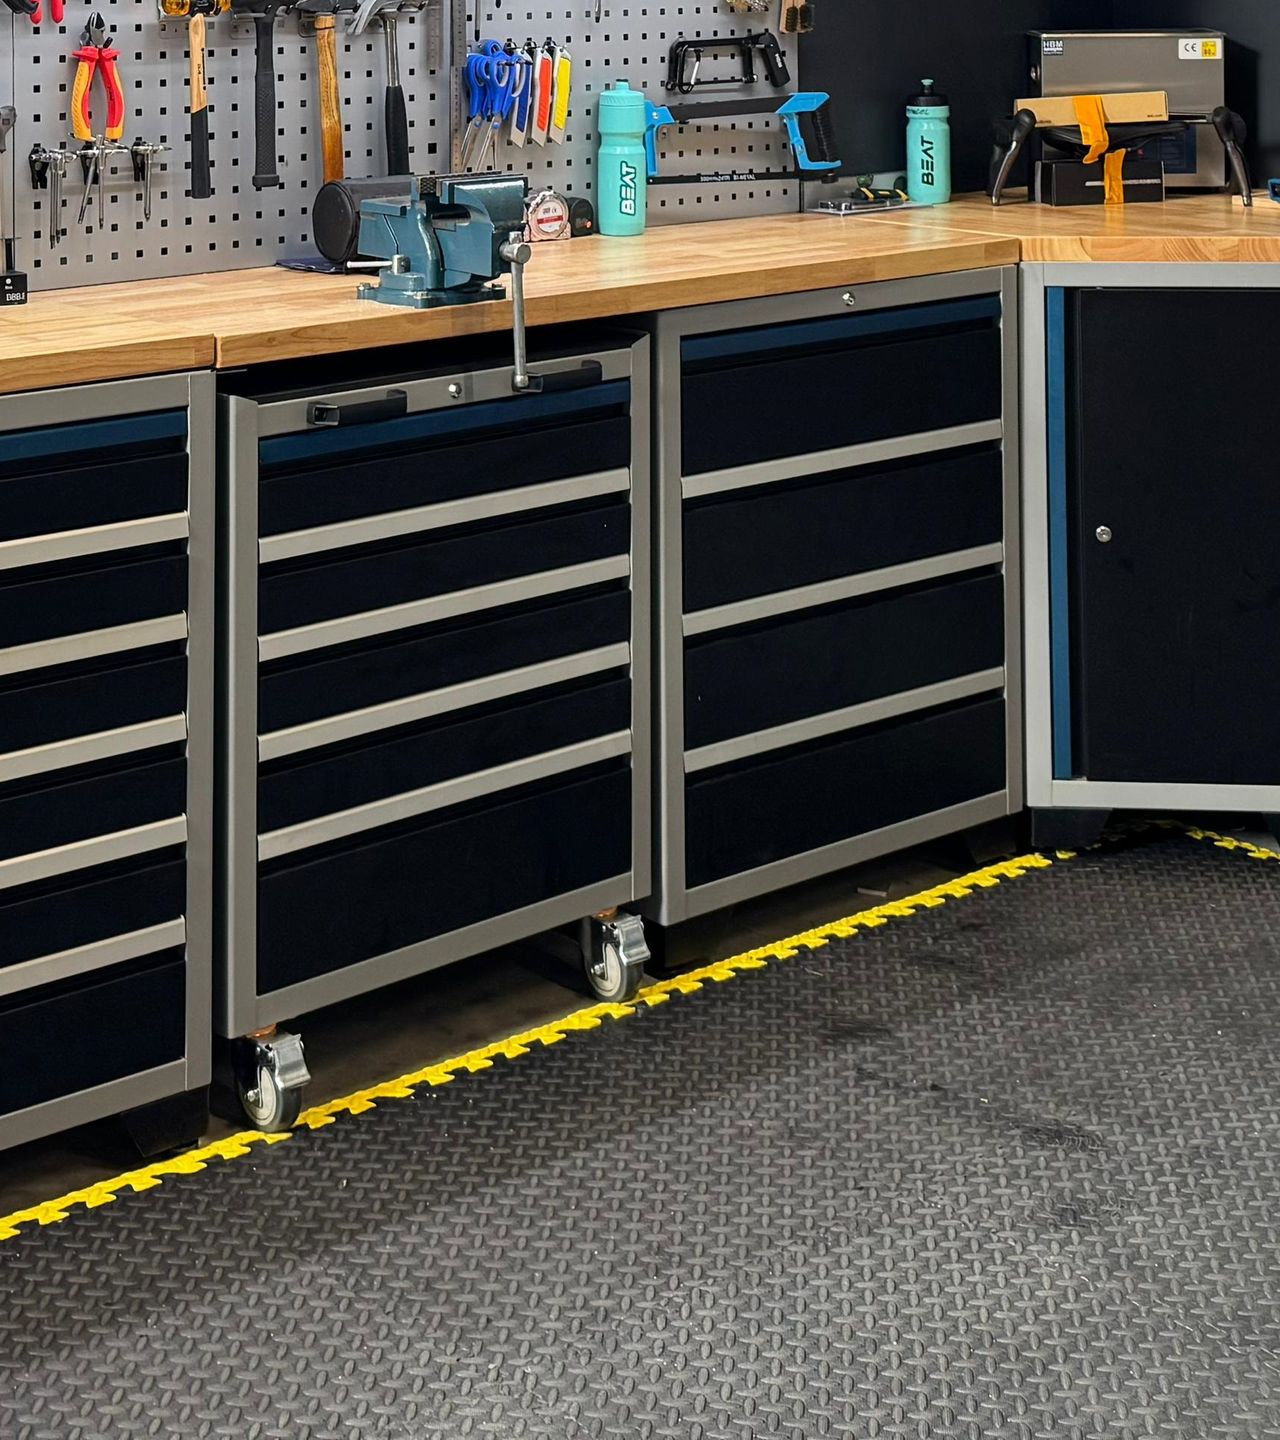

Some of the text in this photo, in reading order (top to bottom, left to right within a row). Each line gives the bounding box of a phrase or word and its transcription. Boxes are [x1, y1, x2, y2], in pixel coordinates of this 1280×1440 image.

[1043, 40, 1064, 48] HBM
[920, 135, 934, 186] BEAT
[620, 160, 637, 216] BEAT
